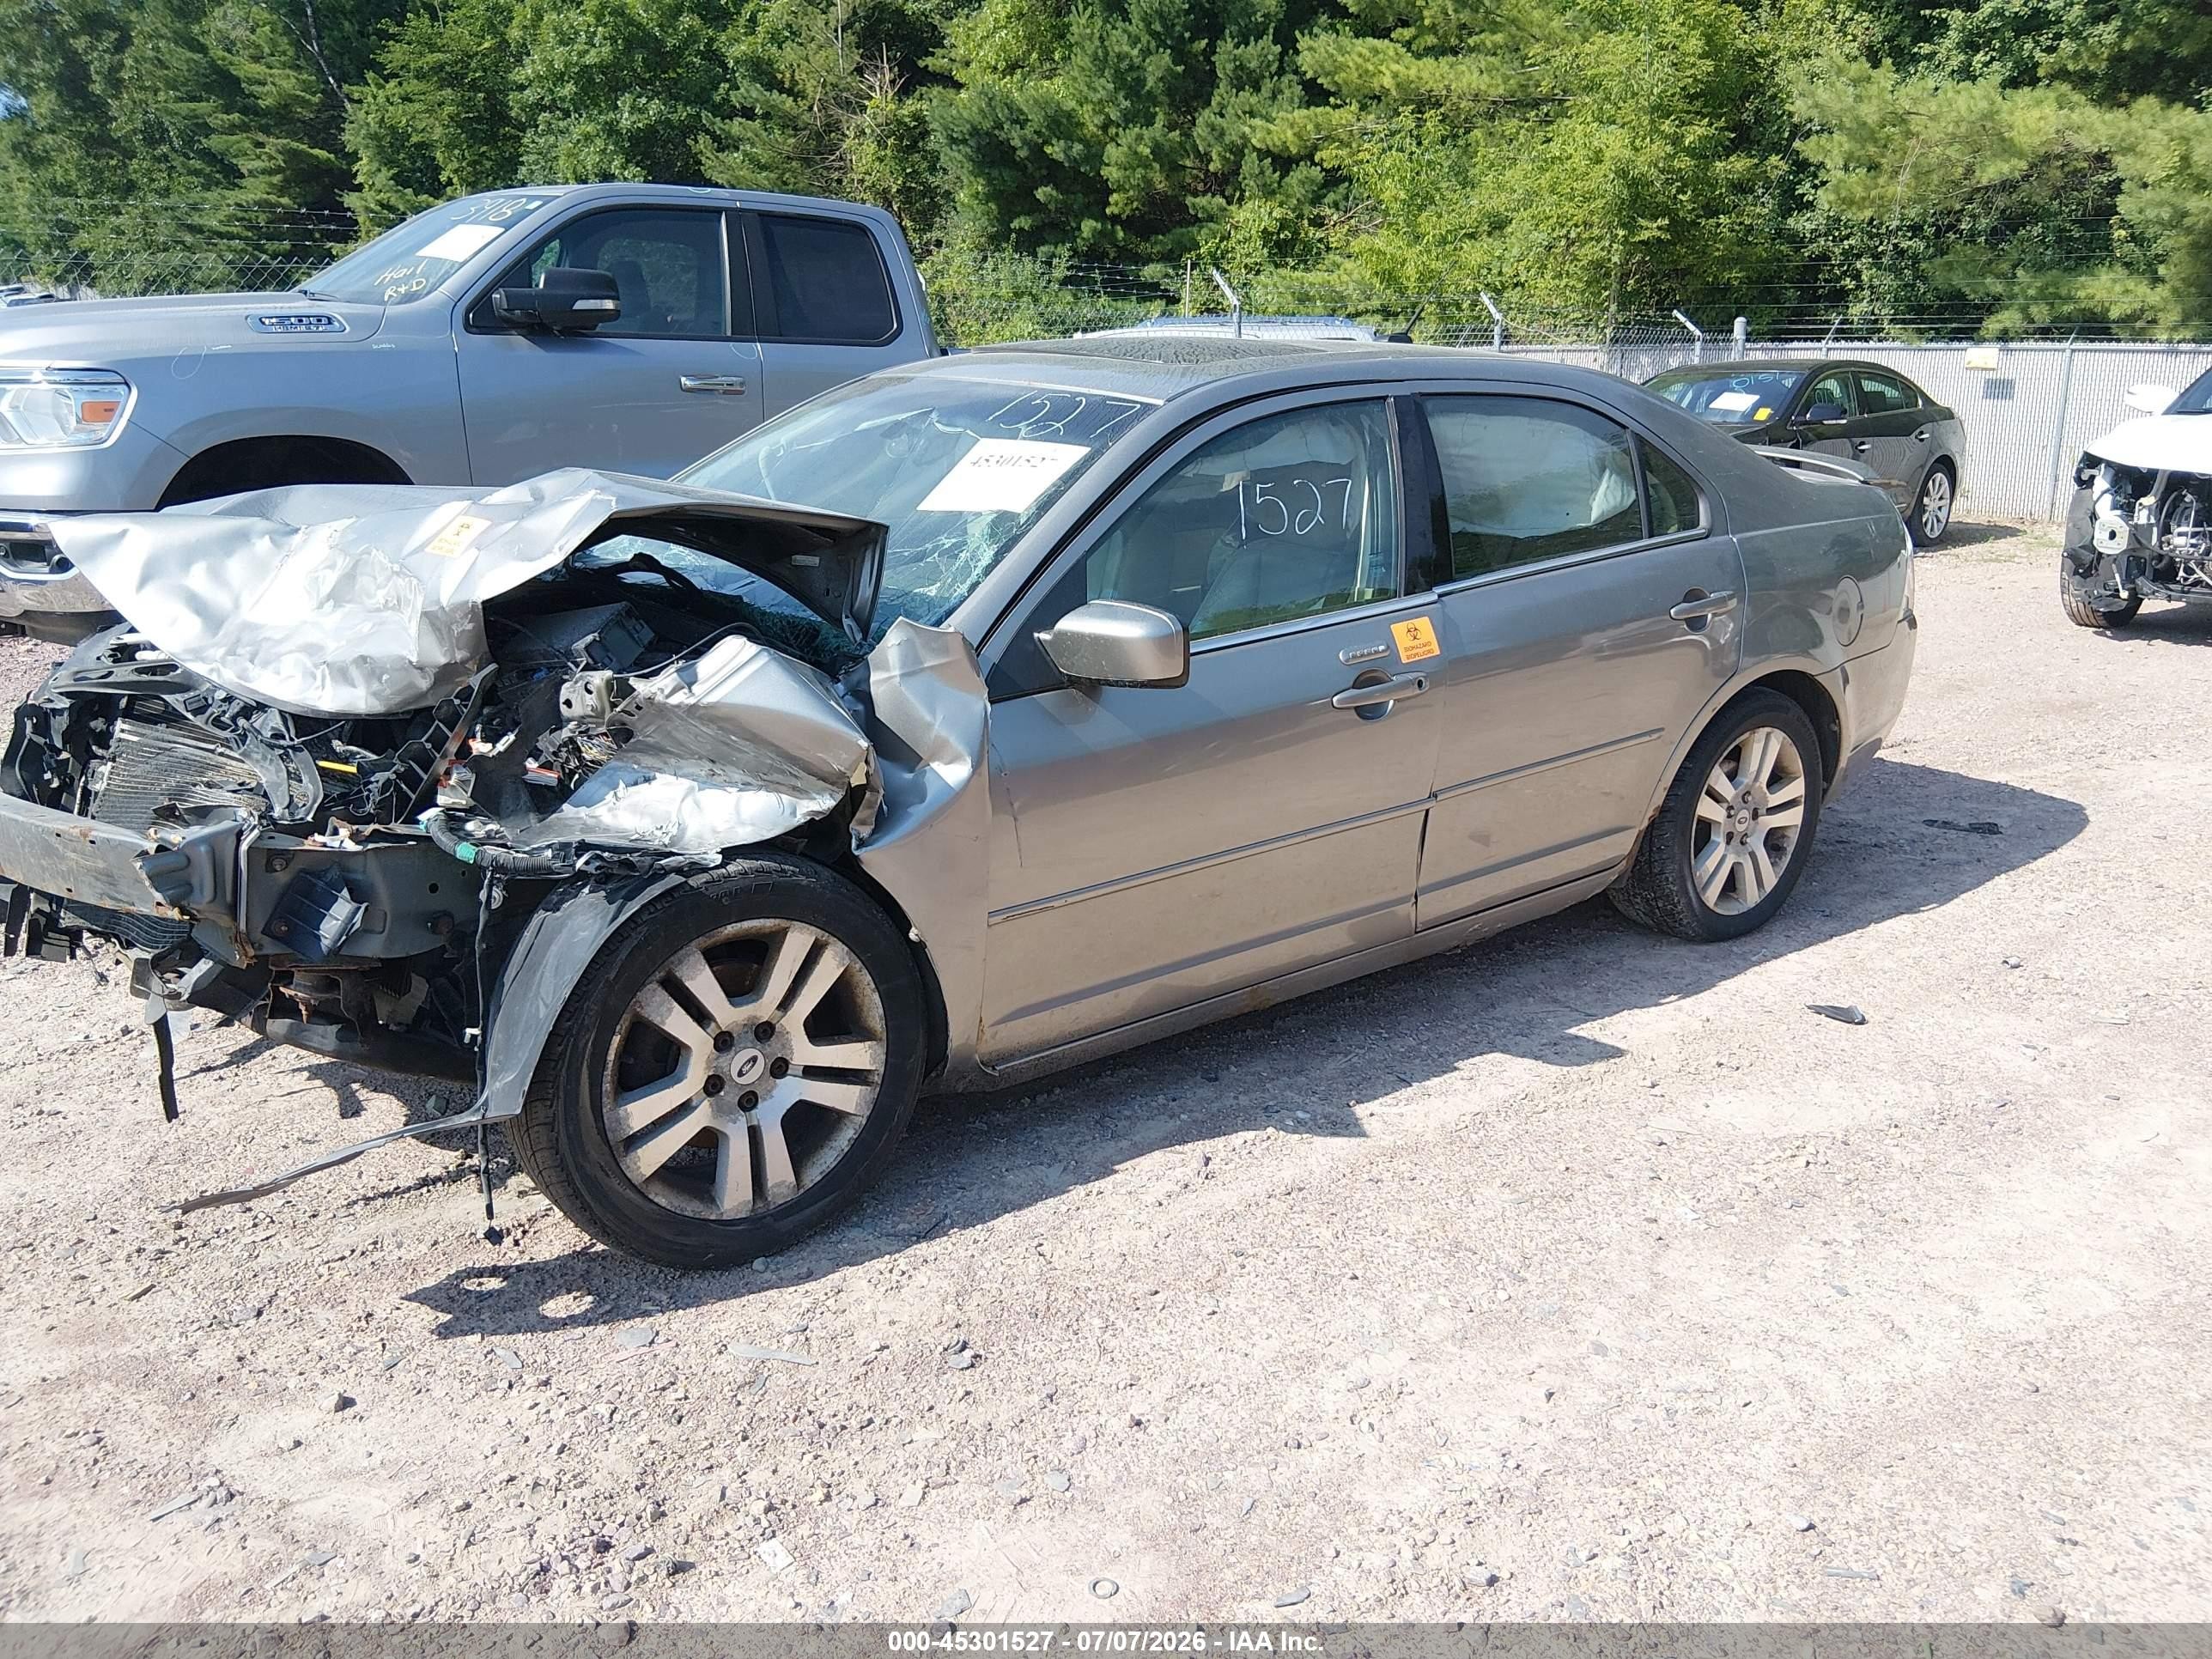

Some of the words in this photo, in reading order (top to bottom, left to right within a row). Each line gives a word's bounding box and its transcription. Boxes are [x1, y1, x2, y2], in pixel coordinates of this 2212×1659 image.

[374, 258, 428, 286] Hail
[261, 316, 328, 325] 1500
[986, 390, 1140, 438] 1527
[1239, 478, 1352, 540] 1527
[1403, 641, 1432, 653] BIOHAZARD
